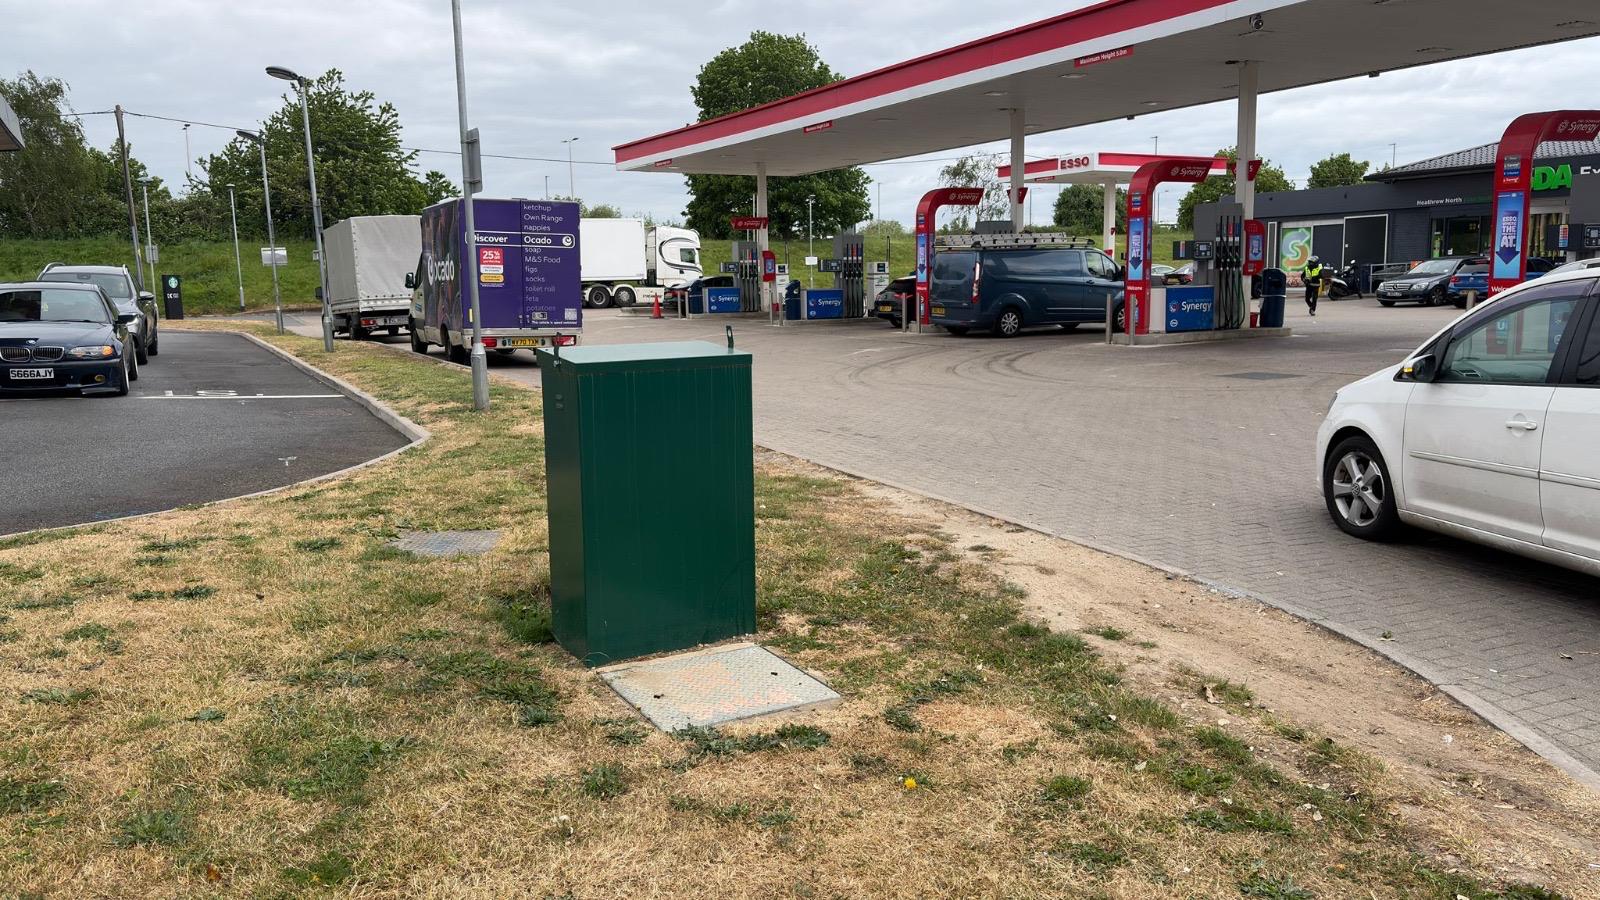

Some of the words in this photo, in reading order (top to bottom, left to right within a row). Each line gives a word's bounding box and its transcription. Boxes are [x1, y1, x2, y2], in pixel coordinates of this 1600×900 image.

[1080, 56, 1100, 65] Maximum
[1101, 52, 1116, 60] Height
[1568, 122, 1599, 134] Synergy
[1060, 156, 1090, 170] ESSO
[1180, 168, 1206, 178] Synergy
[1531, 164, 1572, 191] DA
[523, 202, 552, 212] ketchup
[523, 213, 540, 221] Own
[541, 214, 564, 223] Range
[523, 224, 551, 232] nappies
[1502, 225, 1517, 233] THE
[474, 233, 509, 243] iscover
[523, 235, 552, 245] Ocado
[1500, 235, 1516, 248] AT.
[524, 255, 542, 263] M&S
[543, 256, 561, 264] Food
[524, 265, 538, 273] figs
[718, 295, 739, 303] Synergy
[818, 298, 841, 307] Synergy
[1181, 301, 1213, 313] Synergy
[10, 369, 53, 378] S666AJY
